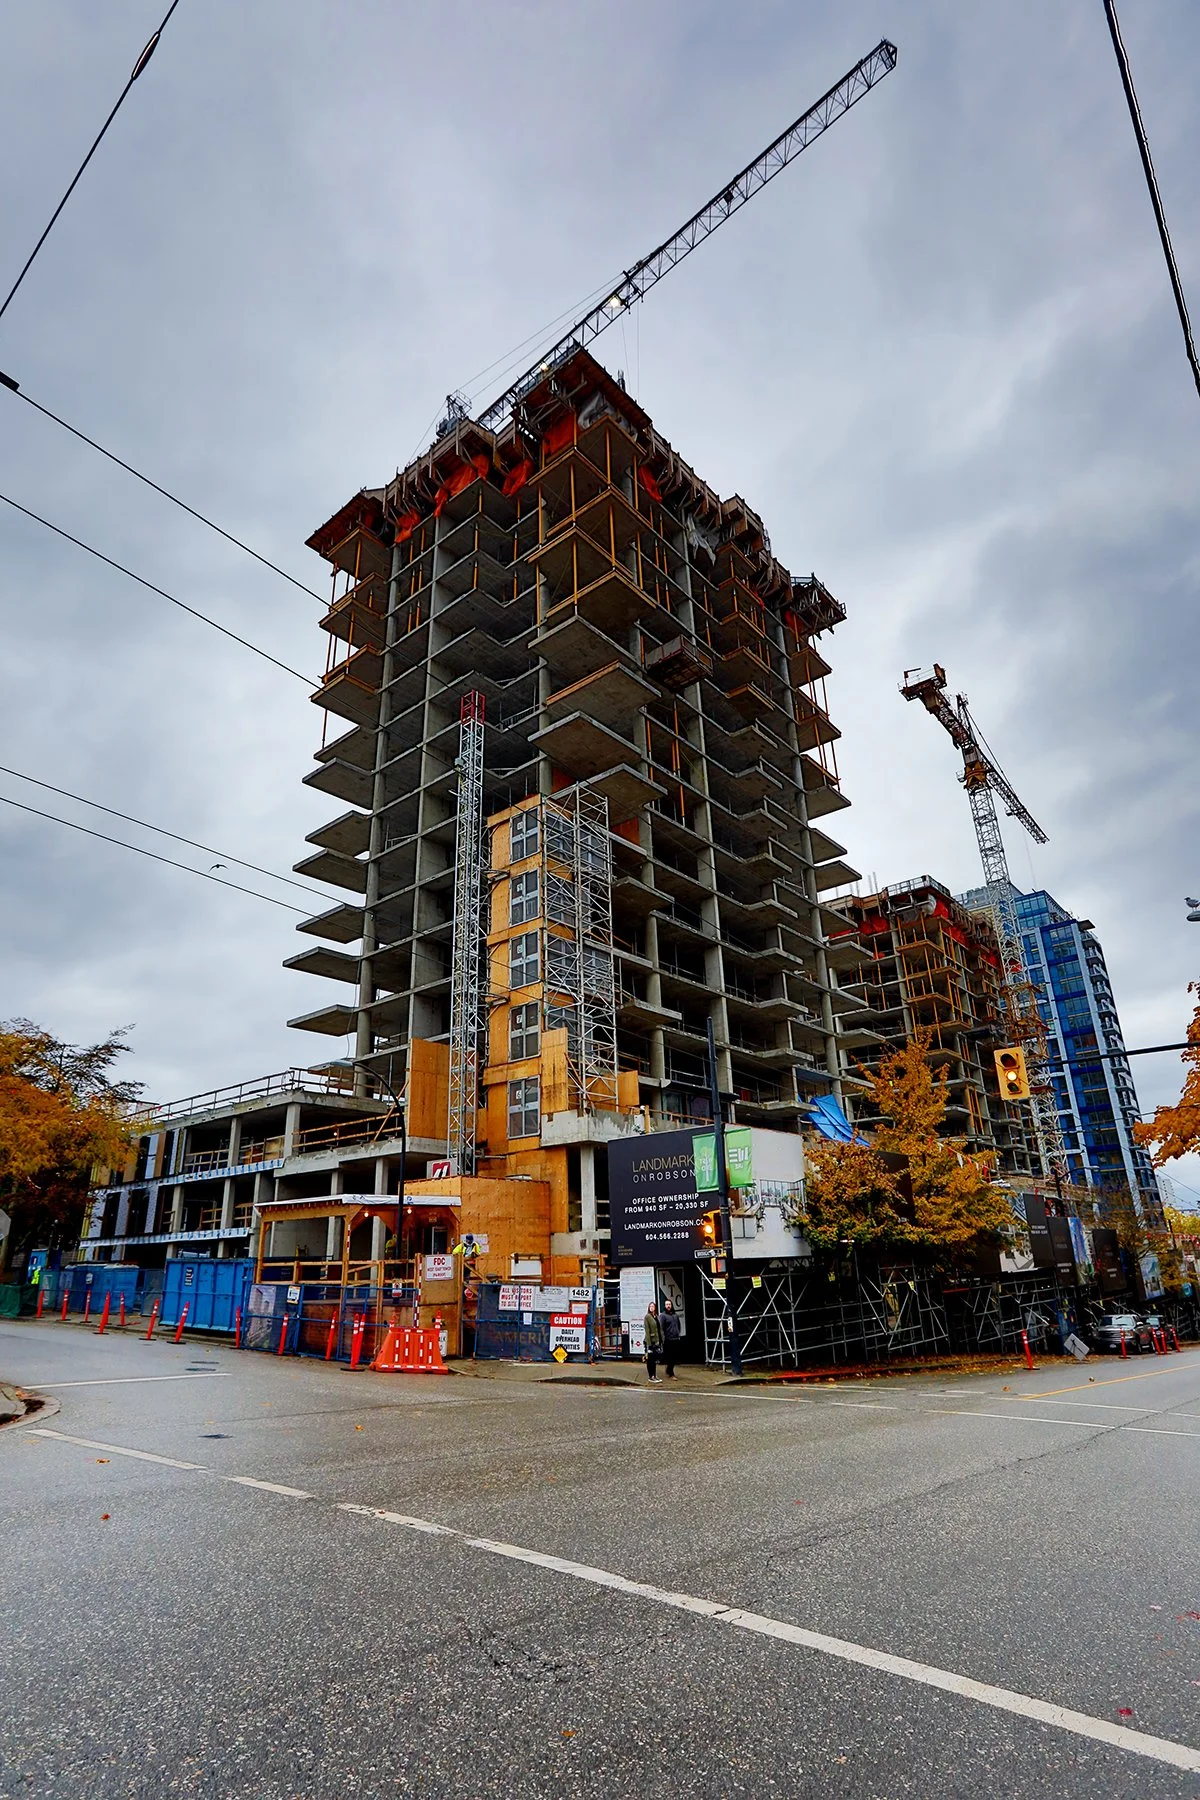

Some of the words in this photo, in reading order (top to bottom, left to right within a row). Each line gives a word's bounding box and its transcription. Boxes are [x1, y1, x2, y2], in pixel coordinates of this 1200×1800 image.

[632, 1154, 694, 1172] LANDMARK
[632, 1196, 656, 1205] OFFICE
[658, 1193, 699, 1202] OWNERSHIP
[675, 1202, 697, 1210] 20,330
[624, 1220, 704, 1230] LANDMARKONROBSON.CO
